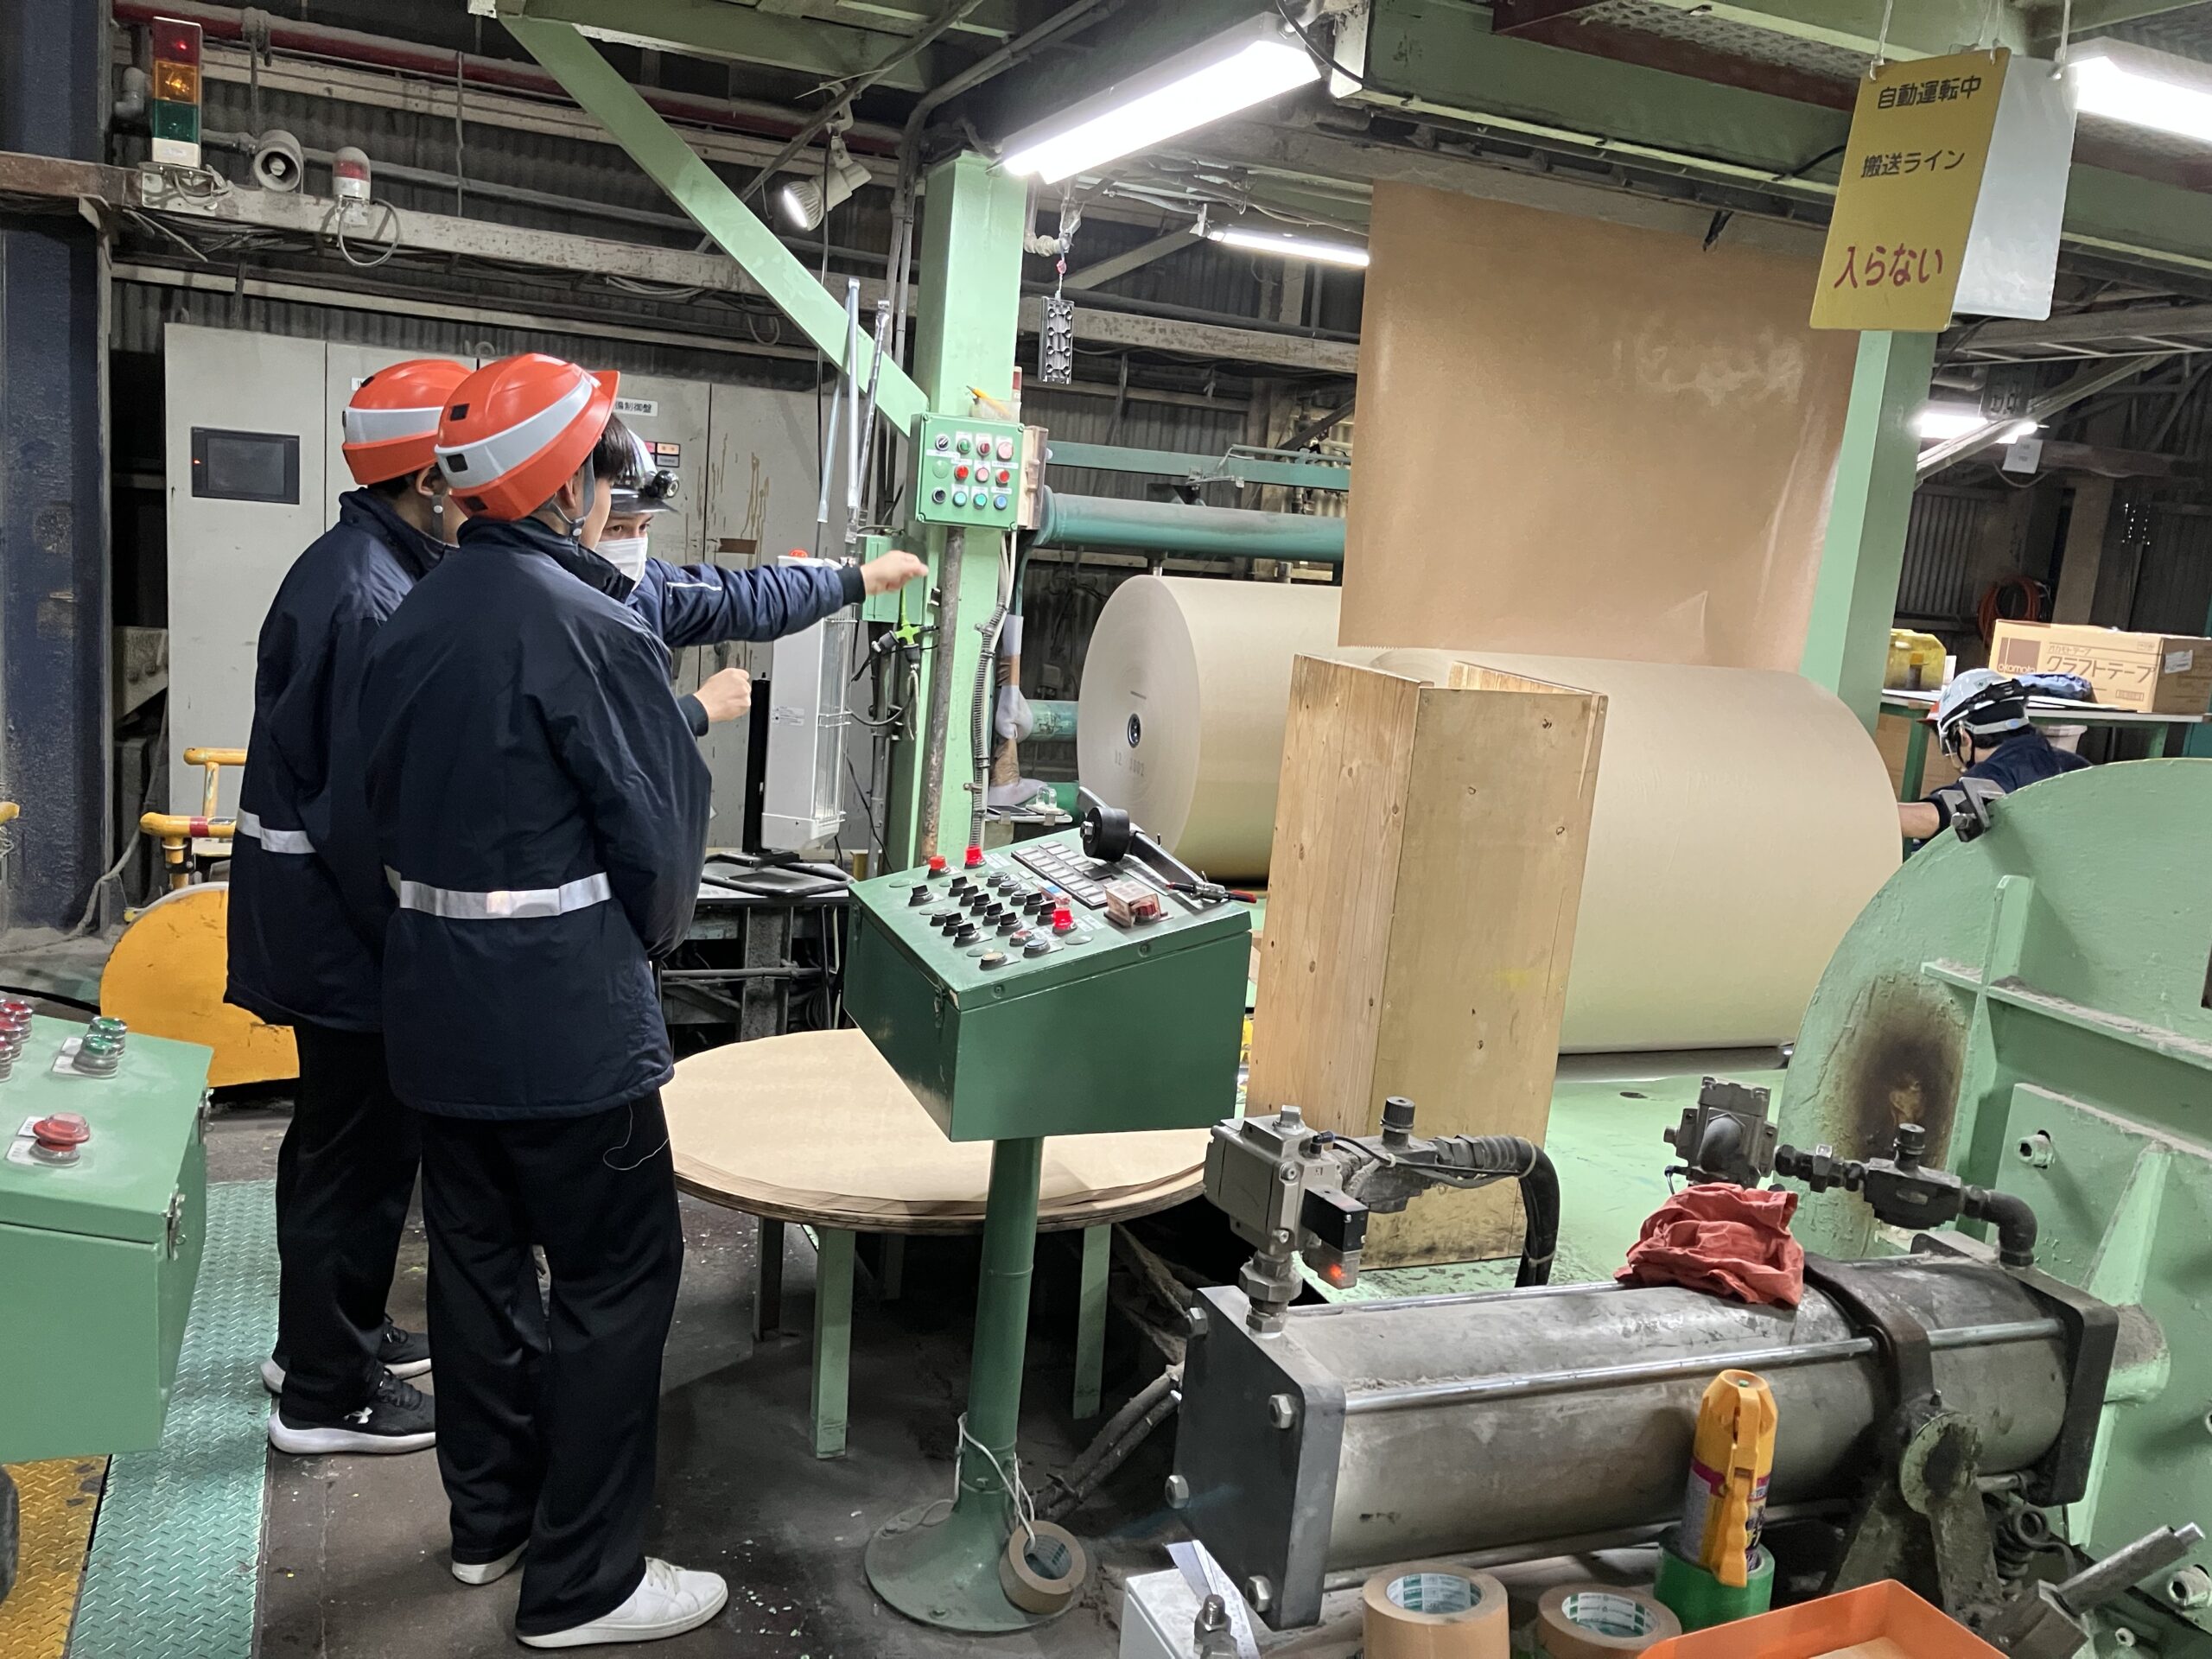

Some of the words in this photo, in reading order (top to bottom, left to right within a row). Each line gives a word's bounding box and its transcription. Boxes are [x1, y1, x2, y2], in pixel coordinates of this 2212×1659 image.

[1878, 75, 1981, 110] 自動運転中
[1861, 149, 1965, 178] 搬送ライン
[1834, 243, 1943, 289] 入らない
[1998, 664, 2036, 674] okamoto
[2046, 655, 2156, 683] クラフトテープ
